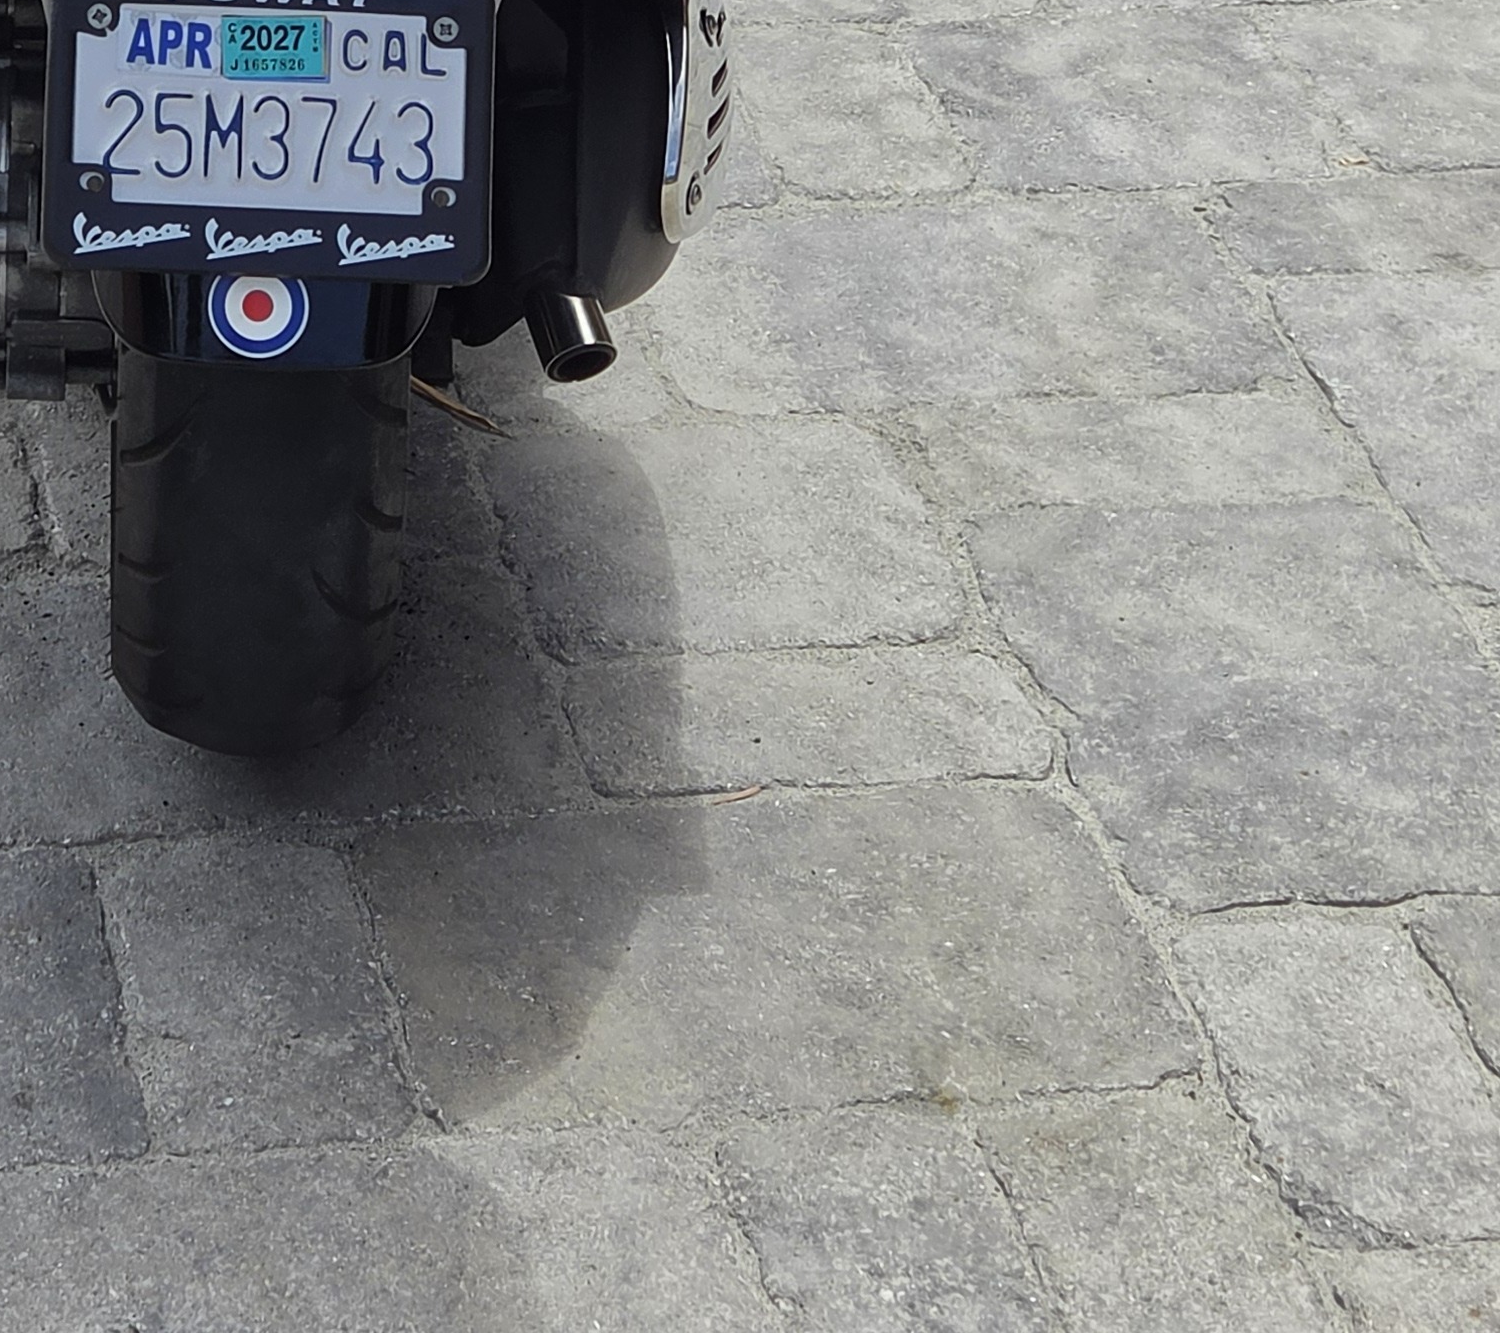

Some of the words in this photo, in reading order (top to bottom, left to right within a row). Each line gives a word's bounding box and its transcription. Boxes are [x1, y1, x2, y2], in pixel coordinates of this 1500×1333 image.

[126, 18, 213, 69] APR
[240, 24, 306, 51] 2027
[342, 29, 448, 77] CAL
[102, 89, 435, 185] 25M3743
[73, 211, 192, 255] Vespa
[205, 218, 323, 261] Vespa
[337, 223, 456, 267] Vespa
